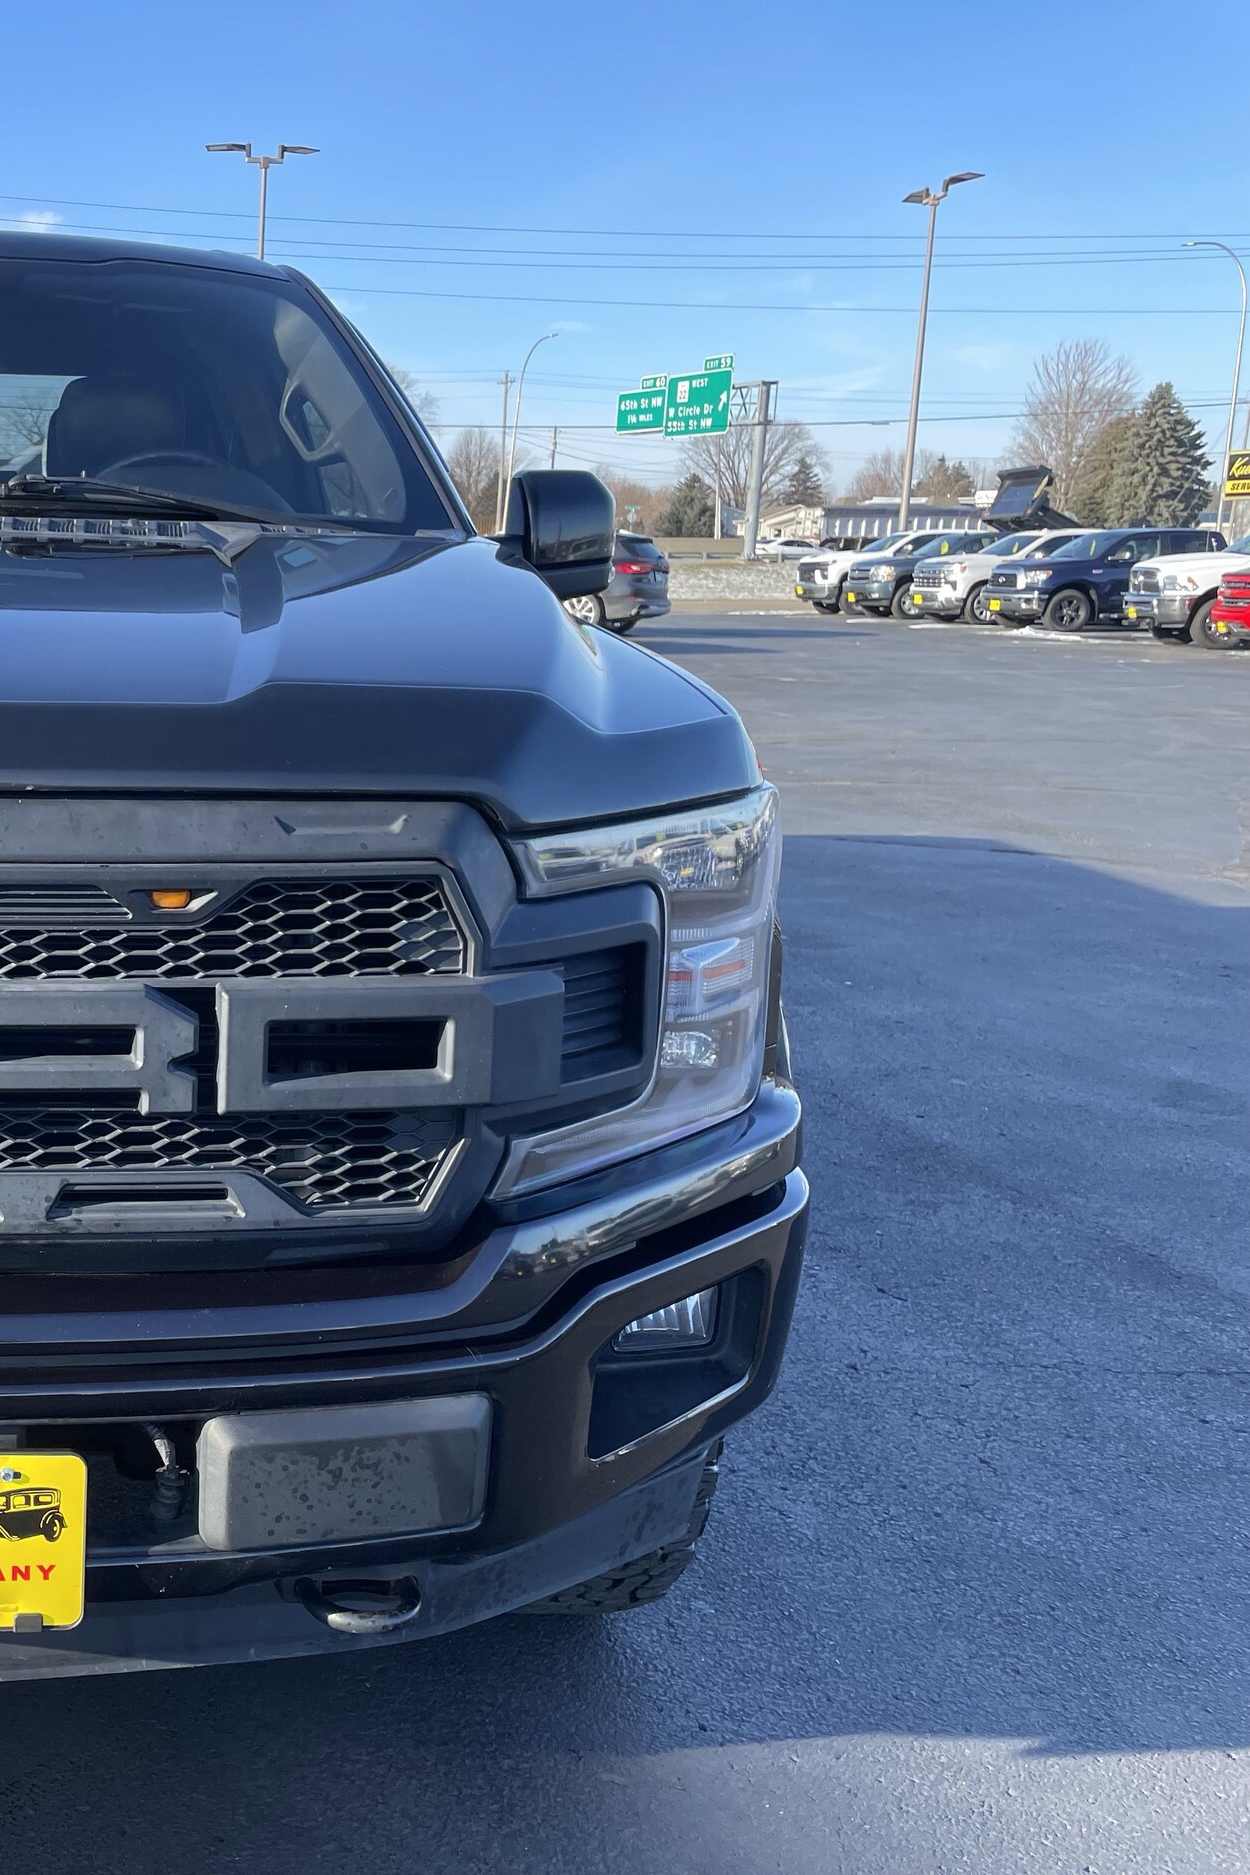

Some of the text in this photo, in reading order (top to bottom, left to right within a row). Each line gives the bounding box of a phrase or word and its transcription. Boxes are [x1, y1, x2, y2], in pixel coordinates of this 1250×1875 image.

[721, 357, 732, 368] 59
[656, 377, 666, 388] 60
[692, 378, 708, 388] WEST
[679, 390, 687, 400] 22
[620, 396, 662, 411] 65th St NW
[668, 403, 713, 418] W Circle Dr
[667, 418, 712, 432] 55th St NW
